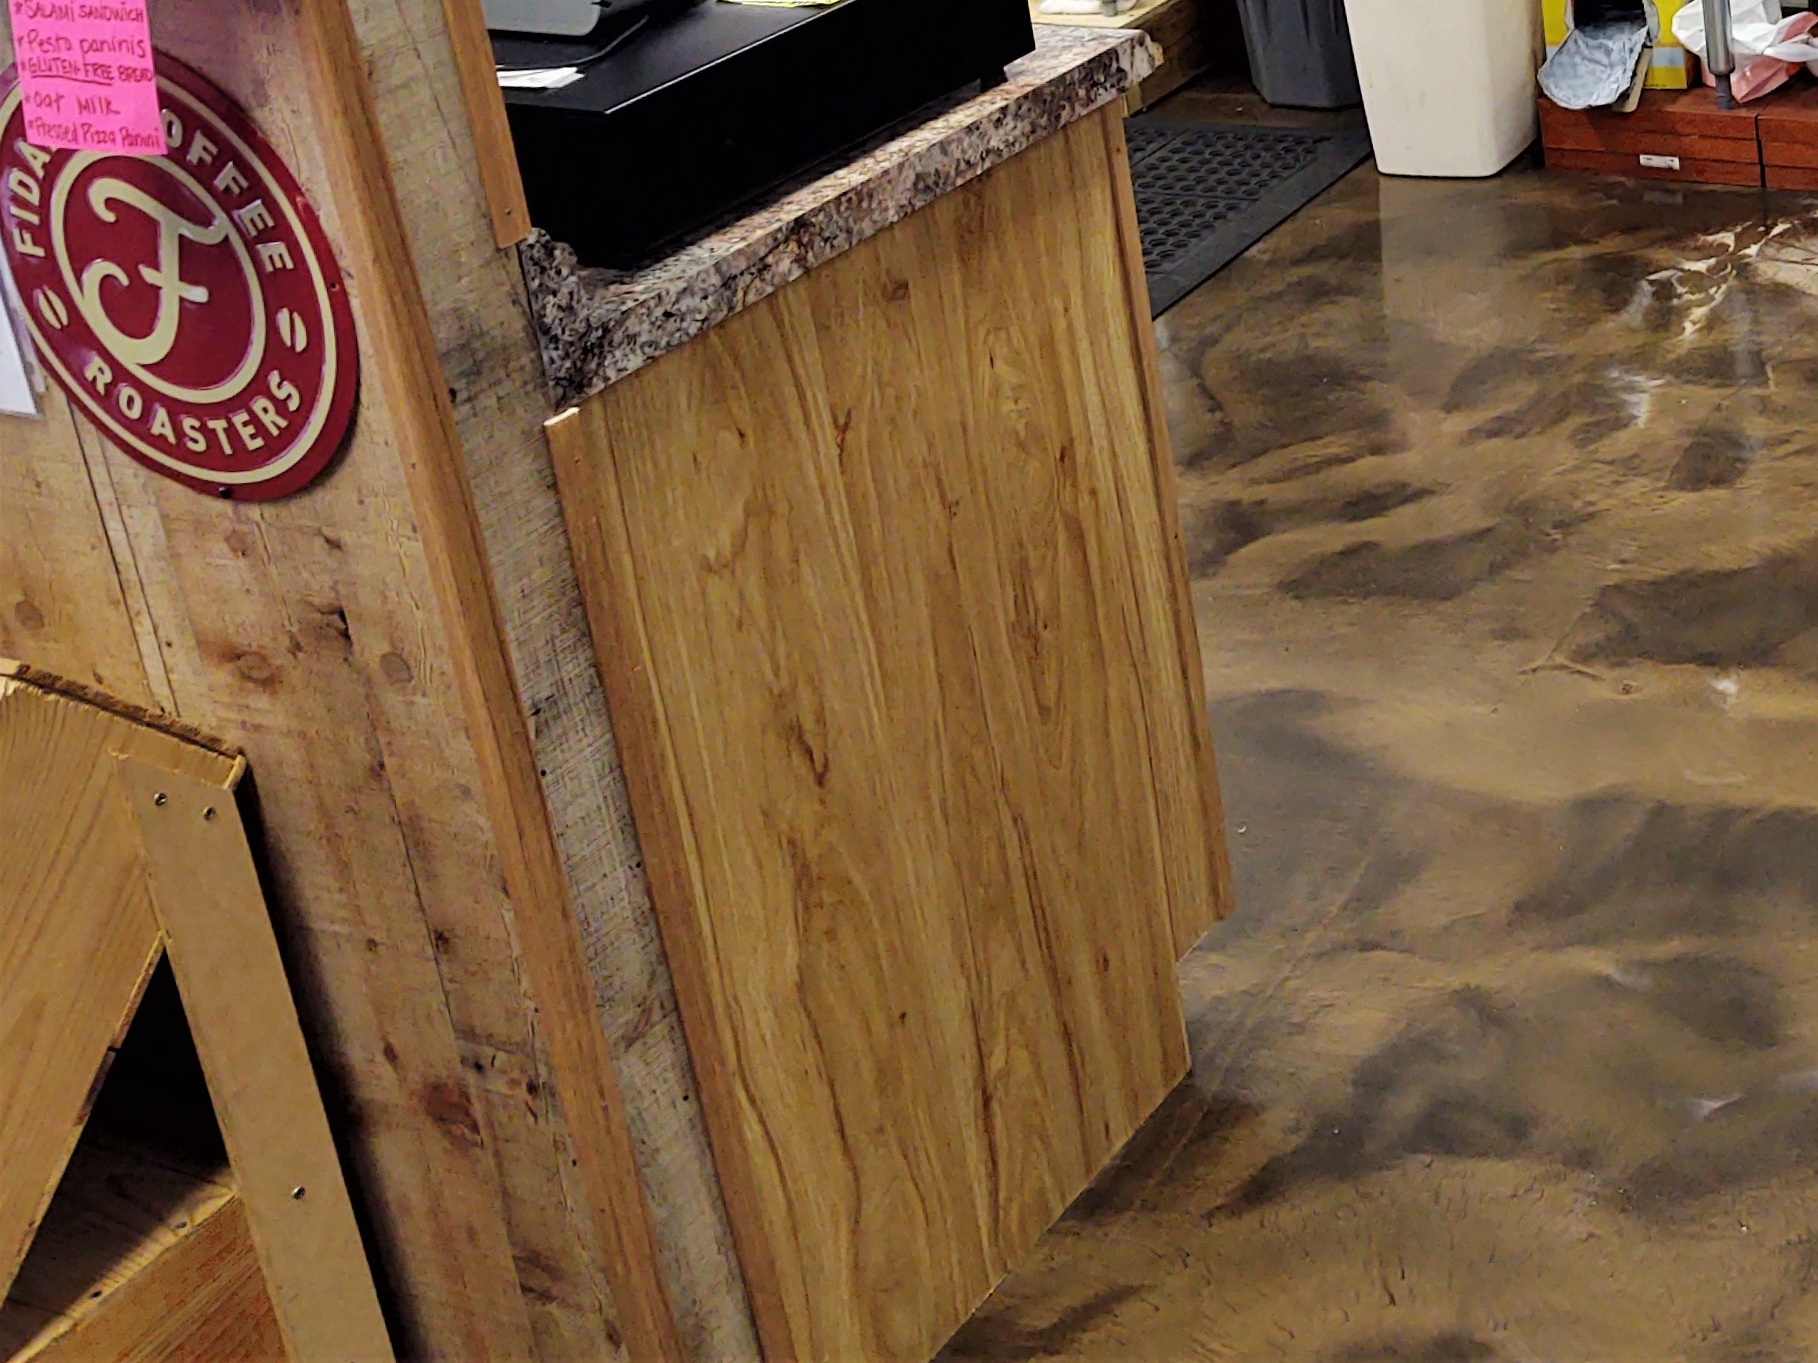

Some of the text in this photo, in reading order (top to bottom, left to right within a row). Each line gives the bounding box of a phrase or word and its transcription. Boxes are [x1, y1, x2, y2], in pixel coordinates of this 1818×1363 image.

[27, 29, 146, 63] Pesto paninis
[117, 64, 154, 83] BREAD
[34, 116, 78, 144] Pressed
[80, 122, 117, 144] Pizza
[84, 357, 302, 458] ROASTERS
